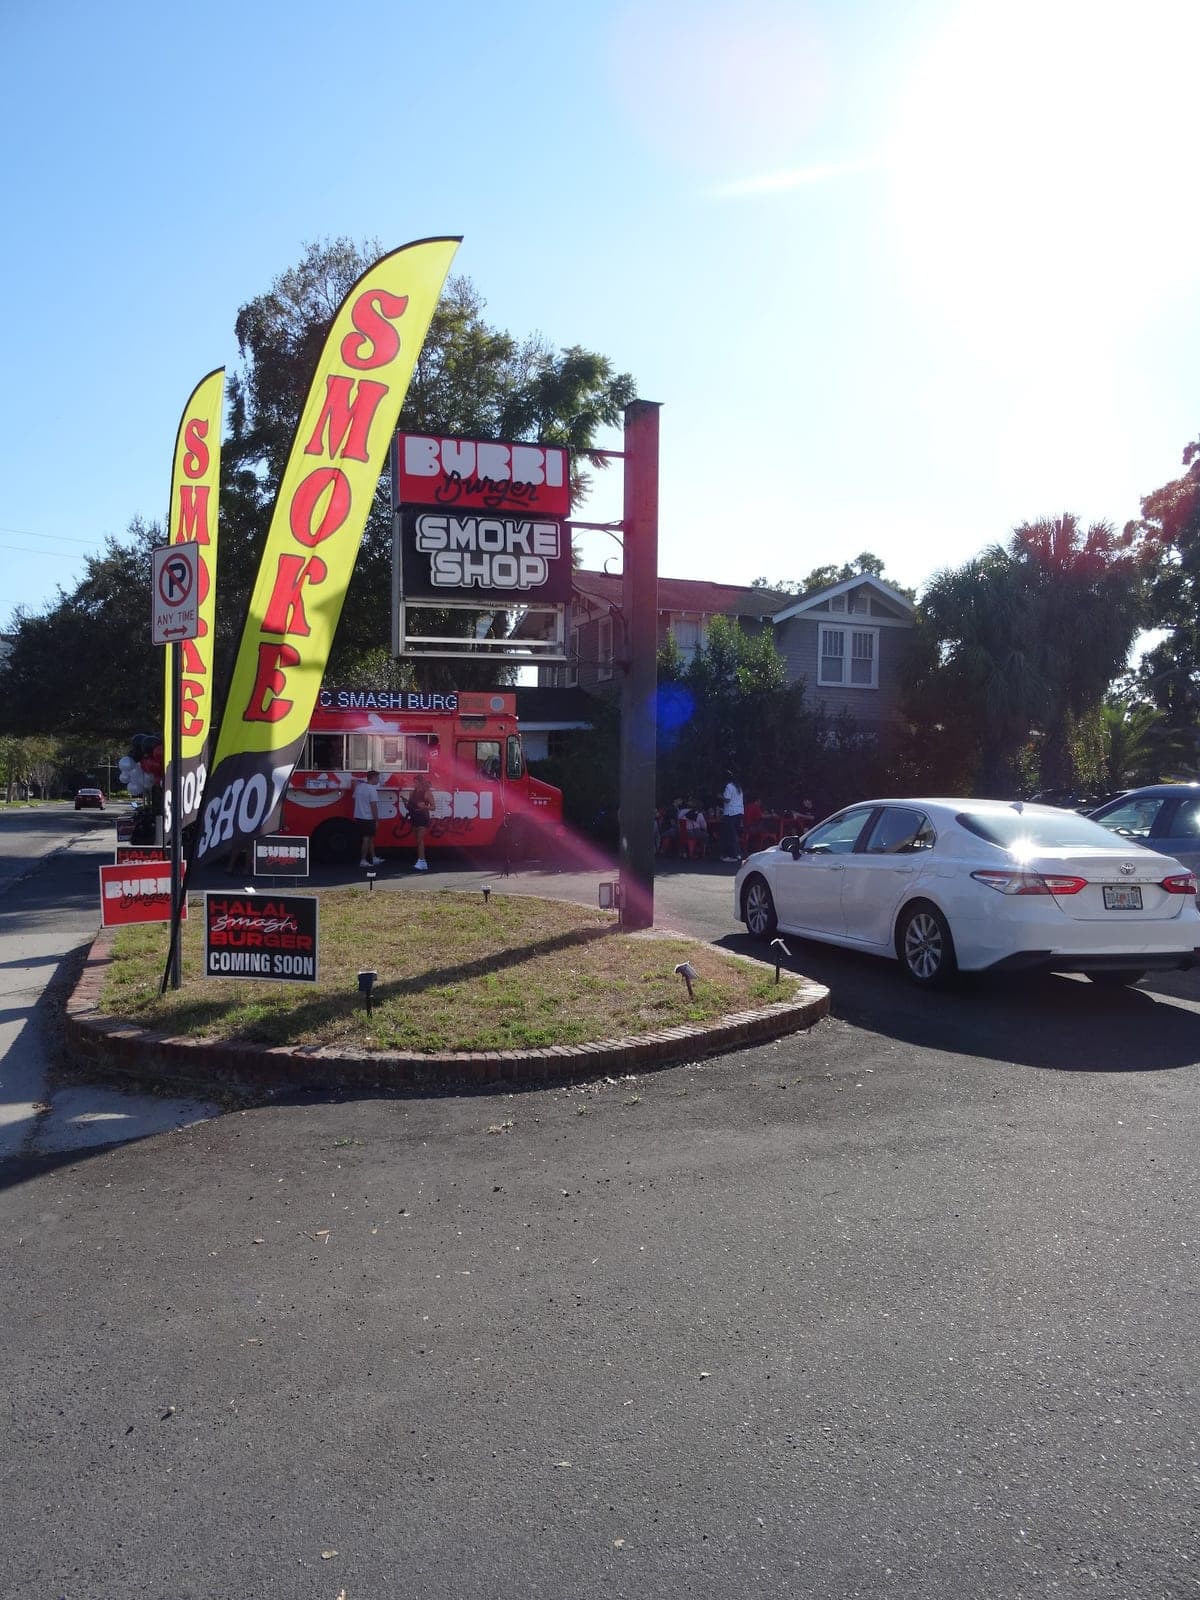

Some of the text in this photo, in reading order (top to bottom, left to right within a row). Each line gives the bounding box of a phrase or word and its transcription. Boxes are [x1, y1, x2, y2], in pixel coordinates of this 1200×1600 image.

[404, 436, 563, 487] BUBBI
[434, 470, 539, 507] Burger
[242, 289, 409, 723] SMOKE
[416, 514, 560, 559] SMOKE
[430, 551, 549, 590] SHOP
[157, 609, 195, 626] ANY TIME
[337, 691, 402, 709] SMASH
[407, 693, 458, 710] BURG
[210, 901, 294, 918] HALAL
[209, 931, 312, 950] BURGER
[209, 952, 313, 976] COMING SOON
